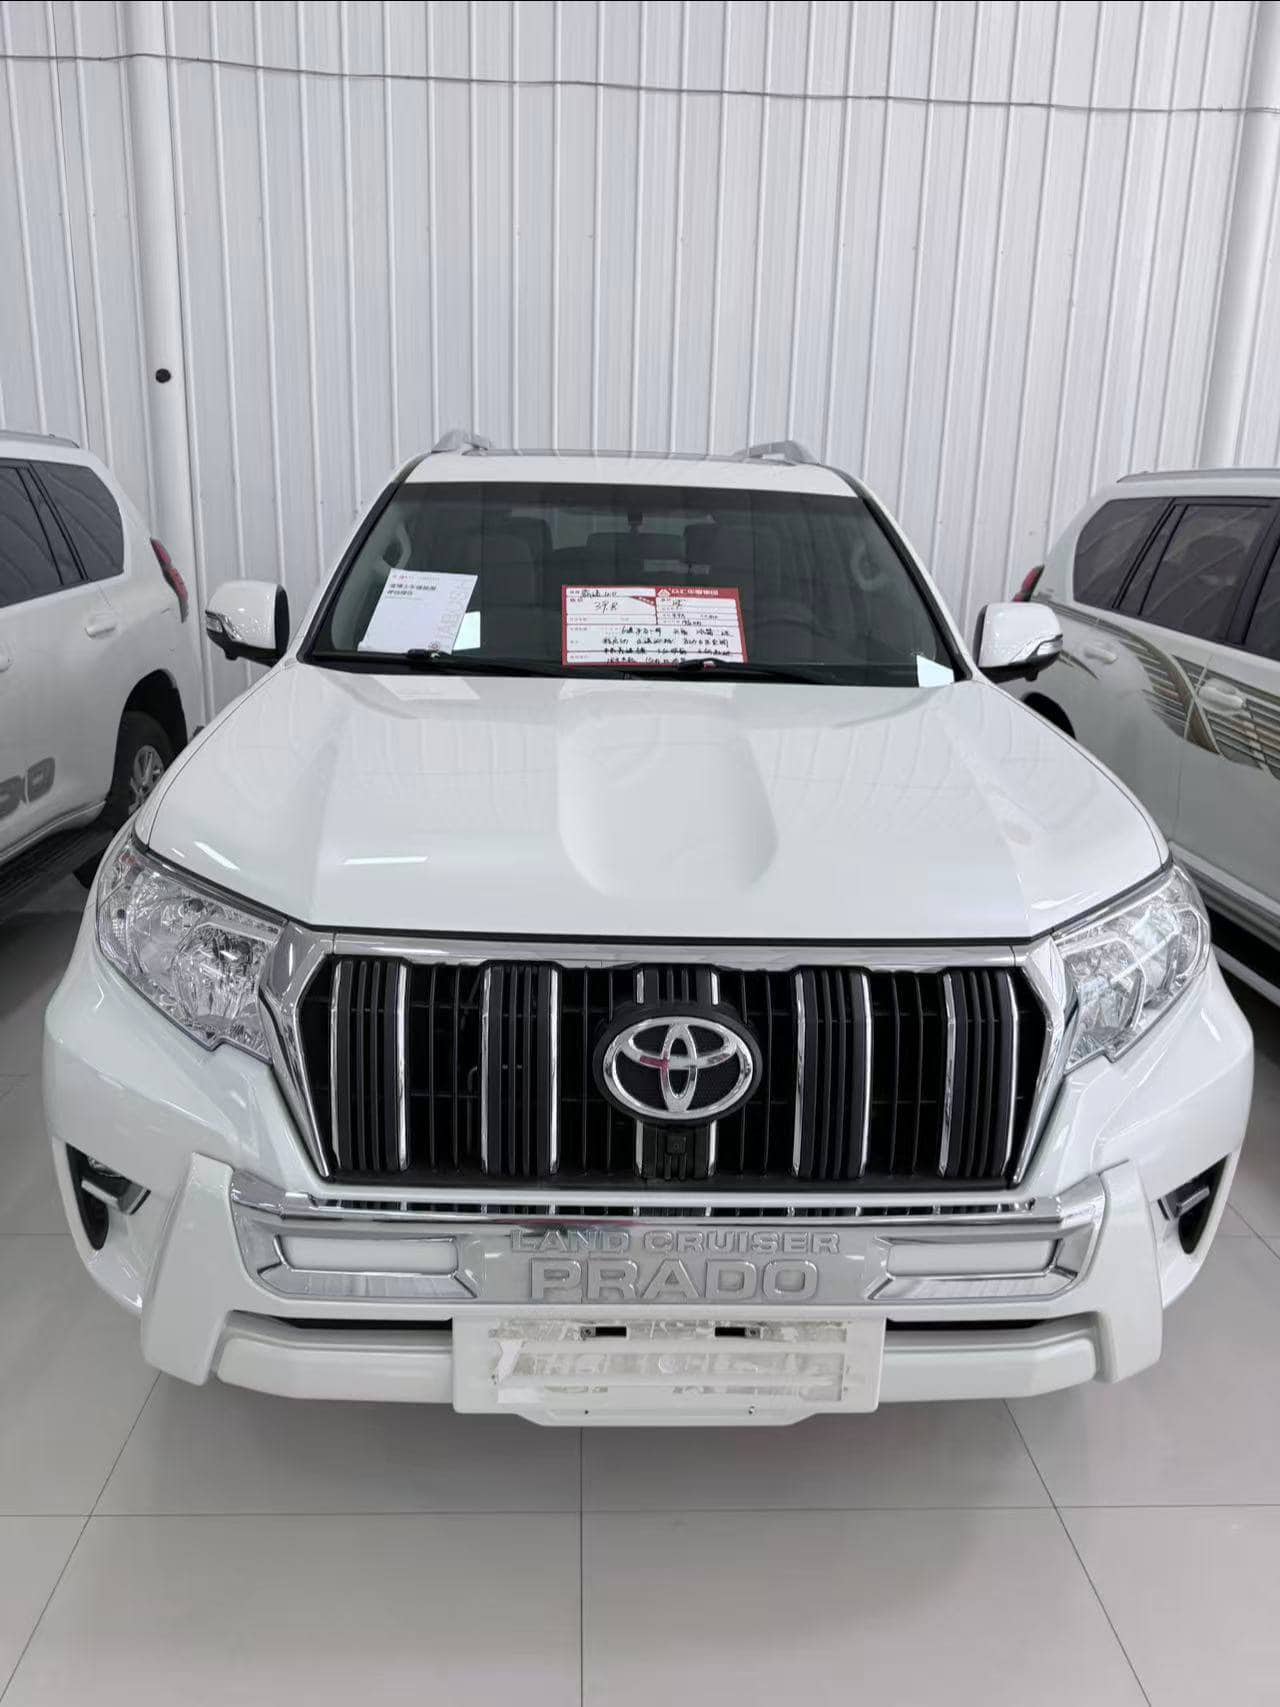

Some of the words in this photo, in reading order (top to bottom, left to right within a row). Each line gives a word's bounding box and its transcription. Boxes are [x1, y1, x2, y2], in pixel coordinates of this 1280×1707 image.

[510, 1230, 631, 1253] LAND
[643, 1230, 840, 1254] CRUISER
[530, 1258, 819, 1303] PRADO
